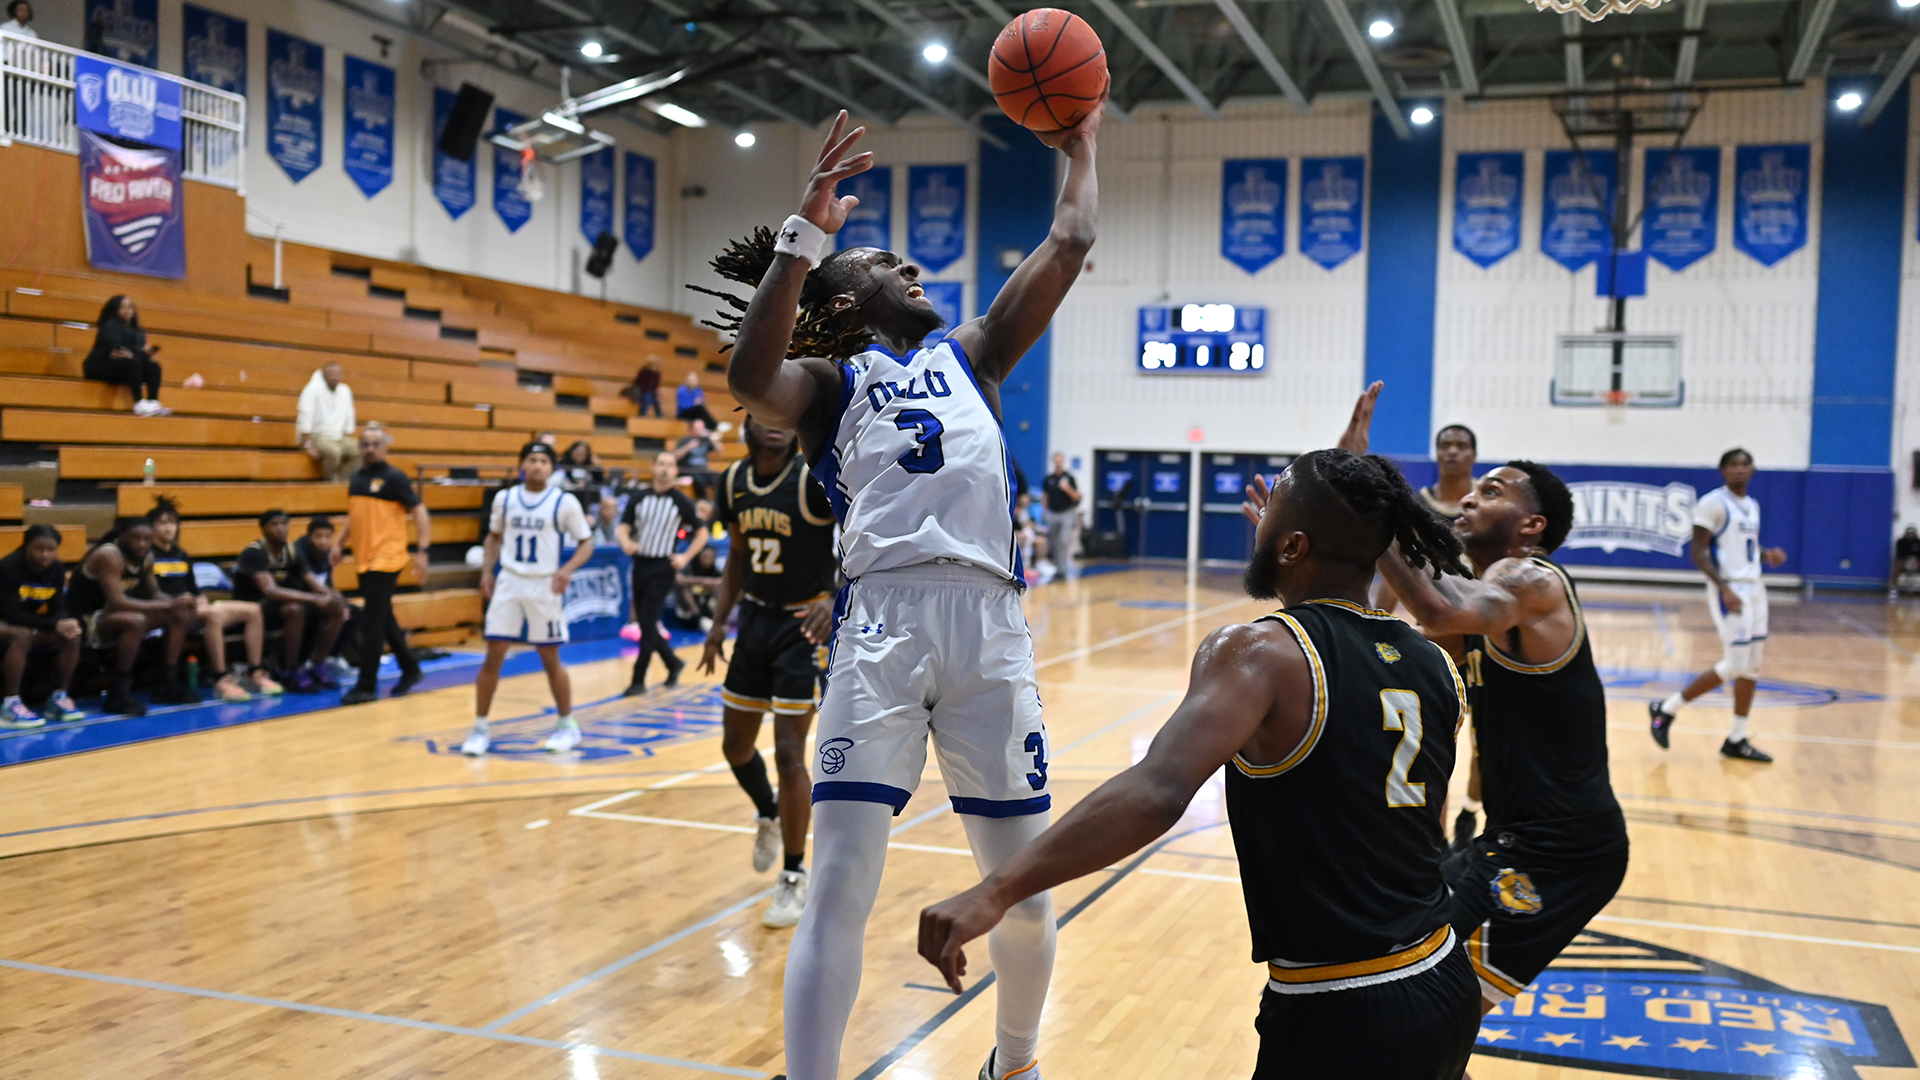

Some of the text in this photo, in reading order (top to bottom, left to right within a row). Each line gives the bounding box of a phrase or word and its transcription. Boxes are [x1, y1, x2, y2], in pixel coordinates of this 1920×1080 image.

[106, 69, 157, 112] OLLU
[90, 176, 173, 204] RED RIVER
[1229, 342, 1265, 370] 21
[866, 368, 952, 413] OLLU
[894, 408, 945, 474] 3
[738, 507, 792, 537] JARVIS
[515, 534, 538, 563] 11
[748, 537, 784, 574] 22
[1024, 731, 1048, 791] 3
[1379, 688, 1427, 808] 2
[1630, 985, 1841, 1015] ATHLETIC
[1645, 998, 1856, 1046] RED
